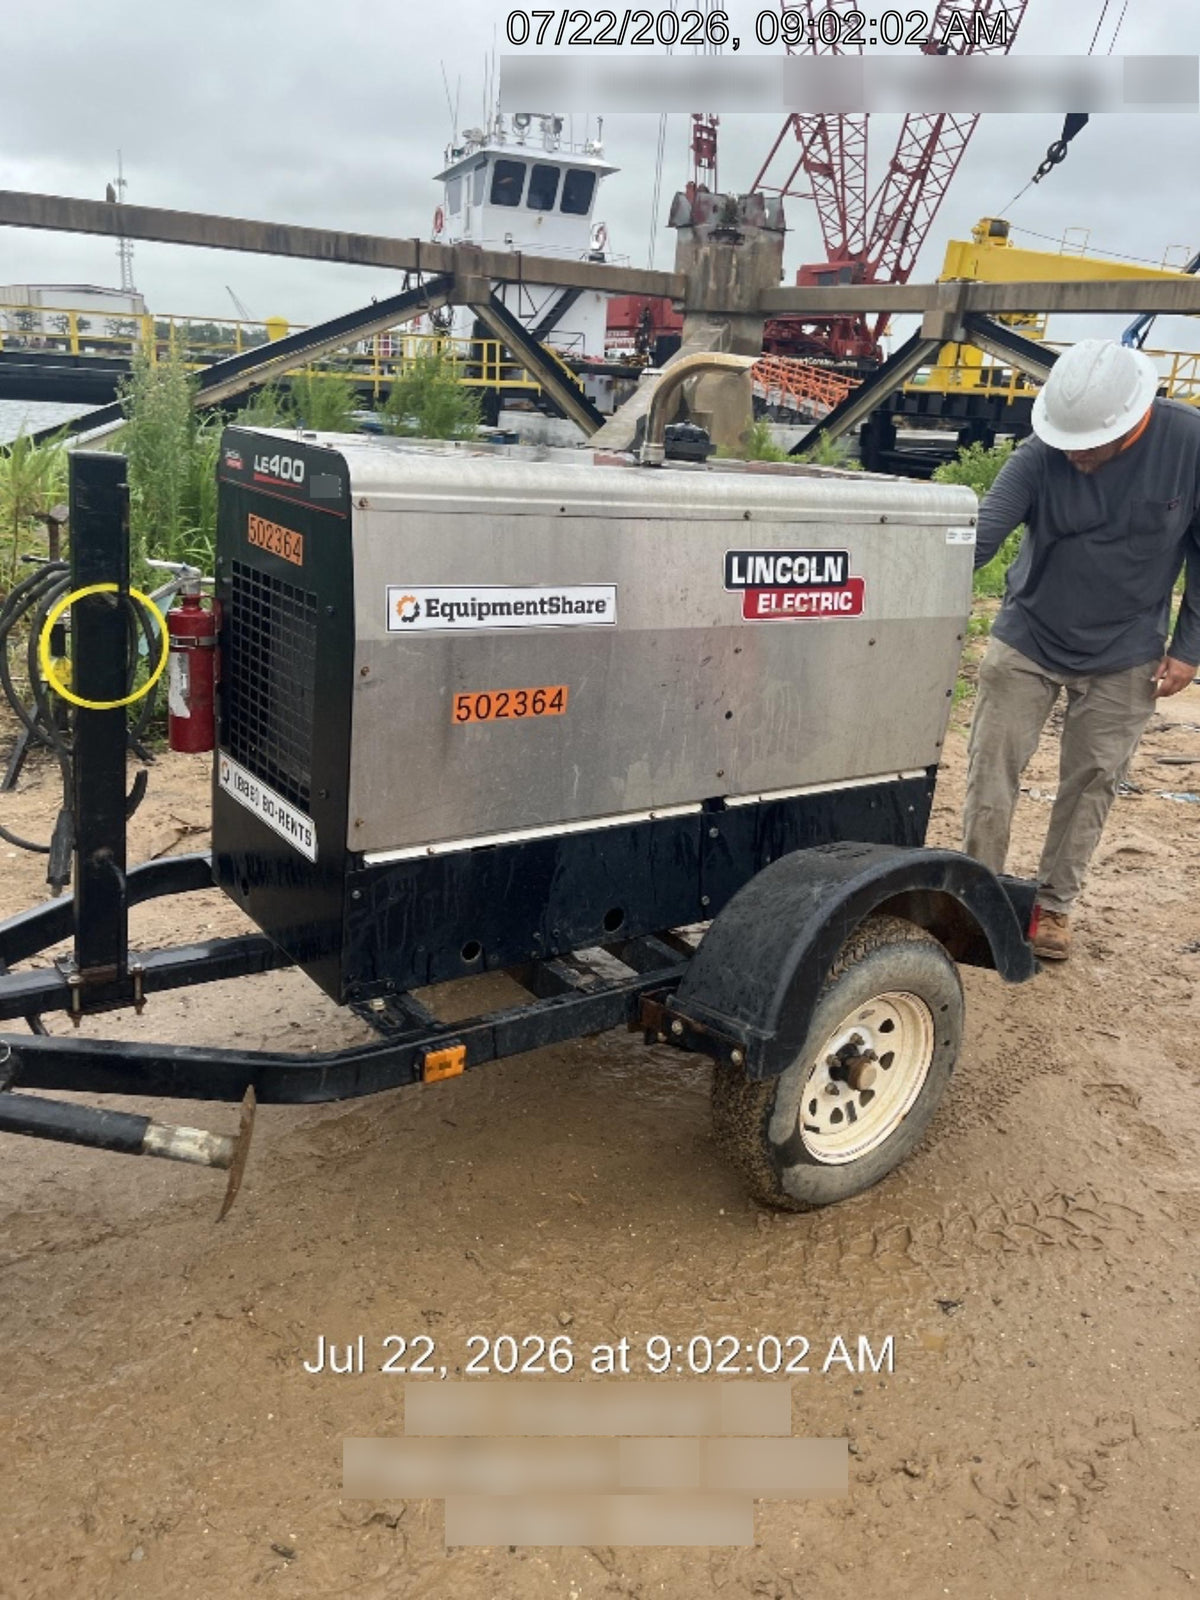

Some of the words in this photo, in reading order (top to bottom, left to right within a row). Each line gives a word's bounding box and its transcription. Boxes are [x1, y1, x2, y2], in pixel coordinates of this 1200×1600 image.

[254, 454, 305, 483] LE400
[249, 516, 302, 559] 502364
[731, 555, 844, 585] LINCOLN
[425, 596, 607, 622] EquipmentShare
[757, 591, 853, 614] ELECTRIC
[456, 688, 564, 722] 502364
